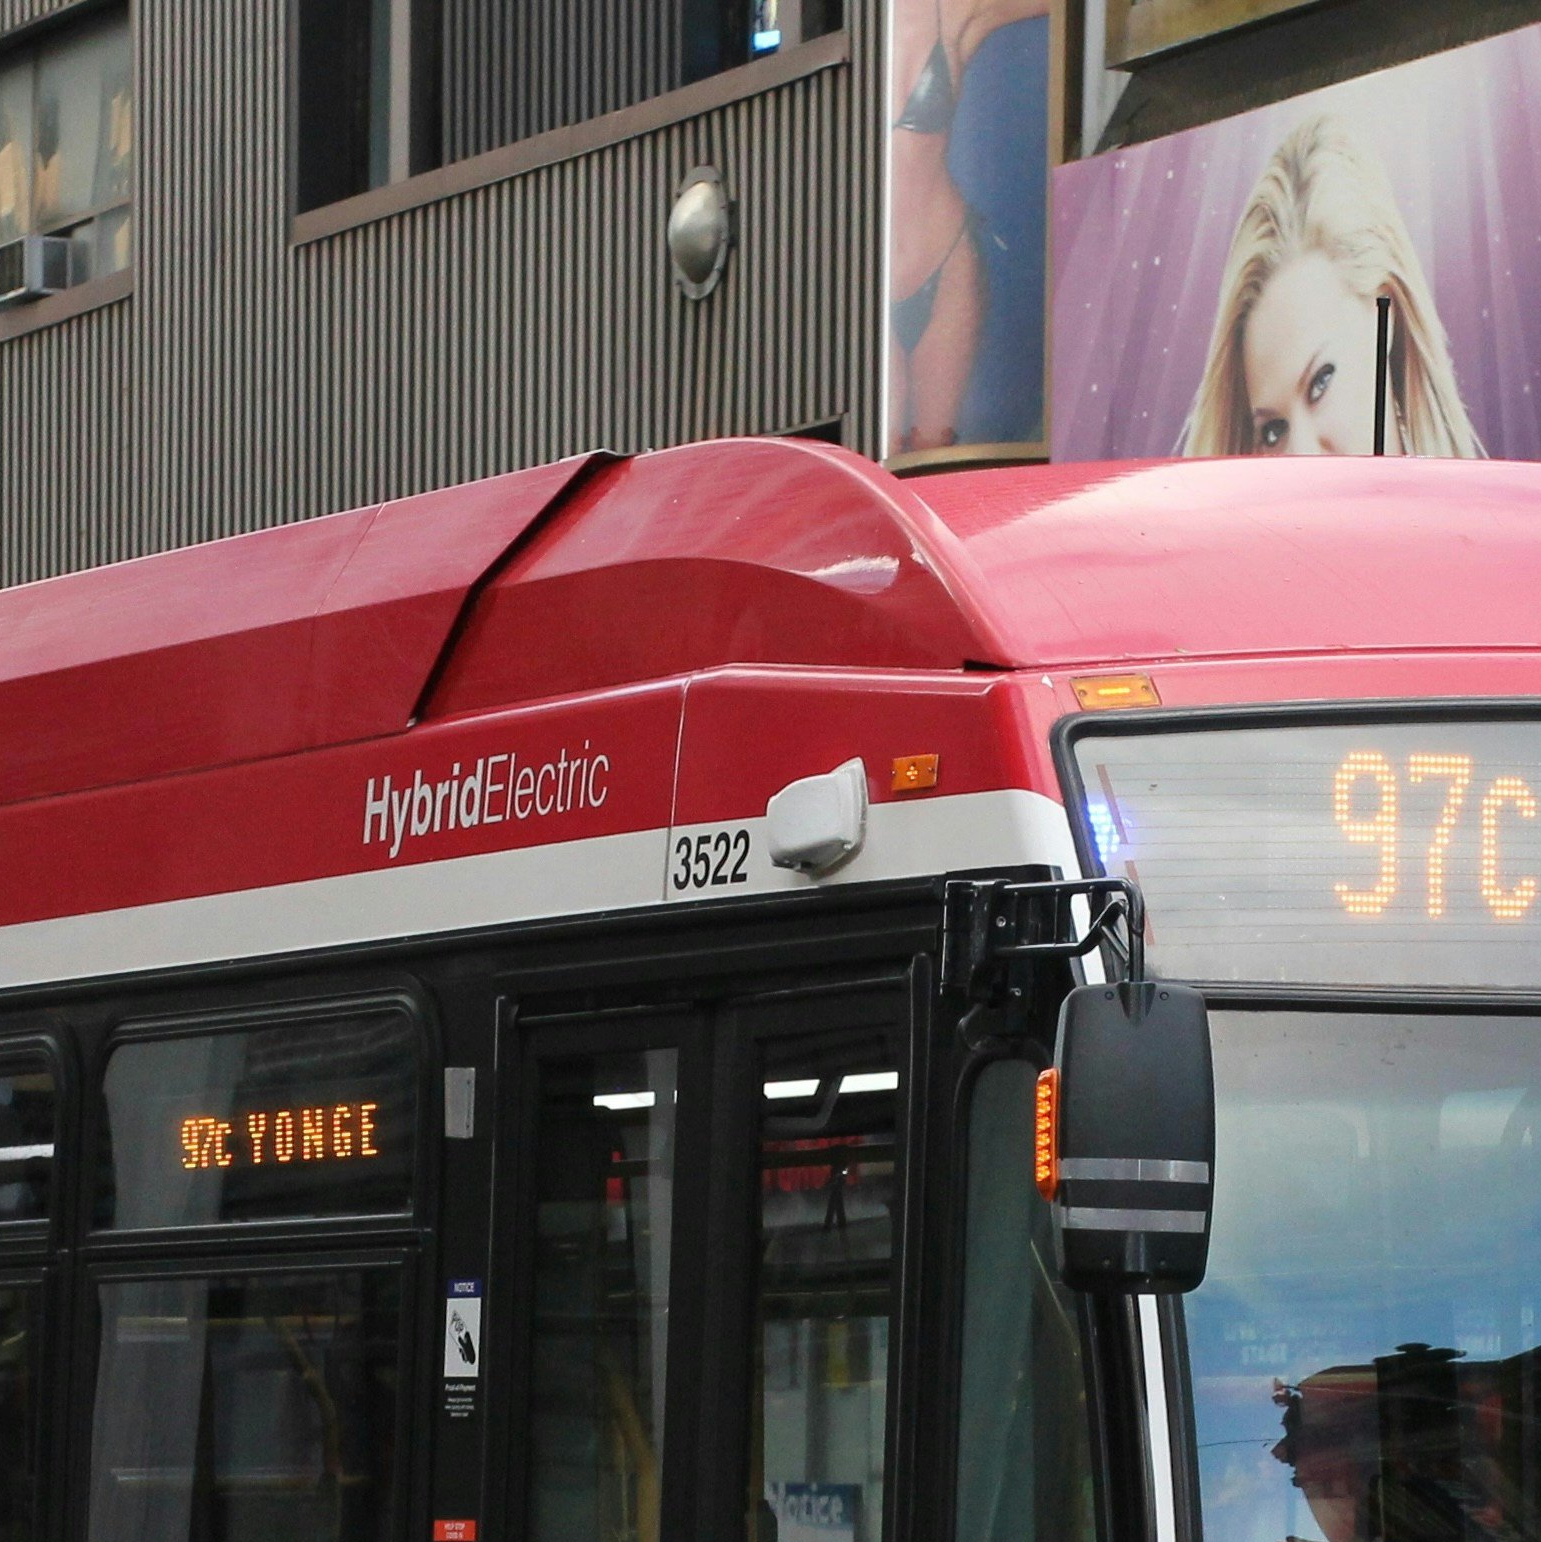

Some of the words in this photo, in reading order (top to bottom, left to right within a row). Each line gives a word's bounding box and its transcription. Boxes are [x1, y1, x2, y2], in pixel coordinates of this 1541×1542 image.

[362, 739, 611, 859] HybridElectric
[1333, 752, 1538, 918] 97C
[672, 829, 751, 891] 3522
[248, 1104, 378, 1164] YONGE
